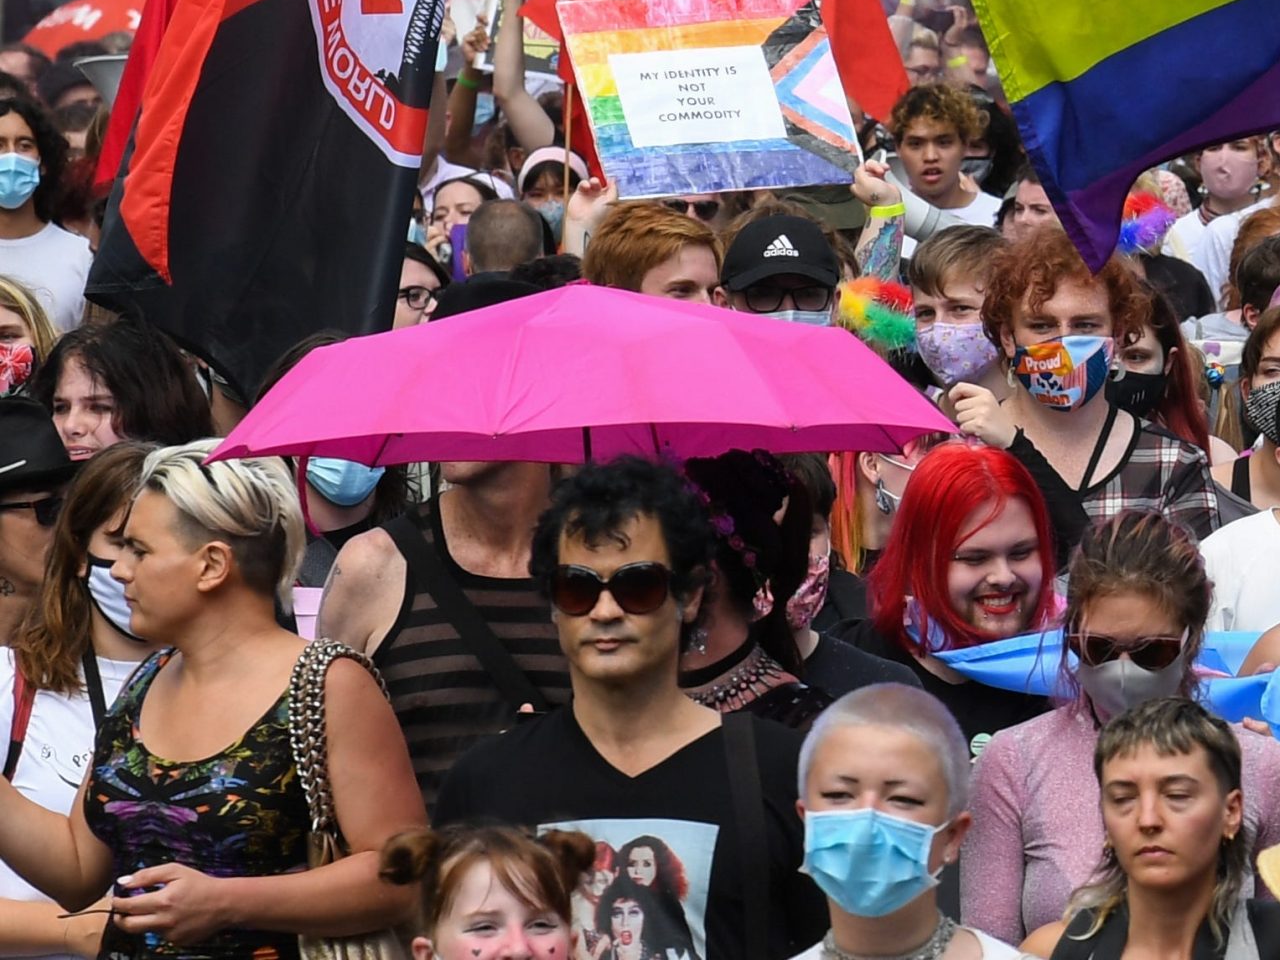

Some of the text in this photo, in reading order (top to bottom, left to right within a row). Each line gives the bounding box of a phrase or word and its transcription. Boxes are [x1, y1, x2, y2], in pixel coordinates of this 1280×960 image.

[640, 66, 737, 80] MY IDENTITY IS
[678, 83, 705, 92] NOT
[676, 96, 715, 106] YOUR
[658, 109, 741, 122] COMMODITY
[763, 247, 799, 258] adidas
[1024, 352, 1061, 372] Proud
